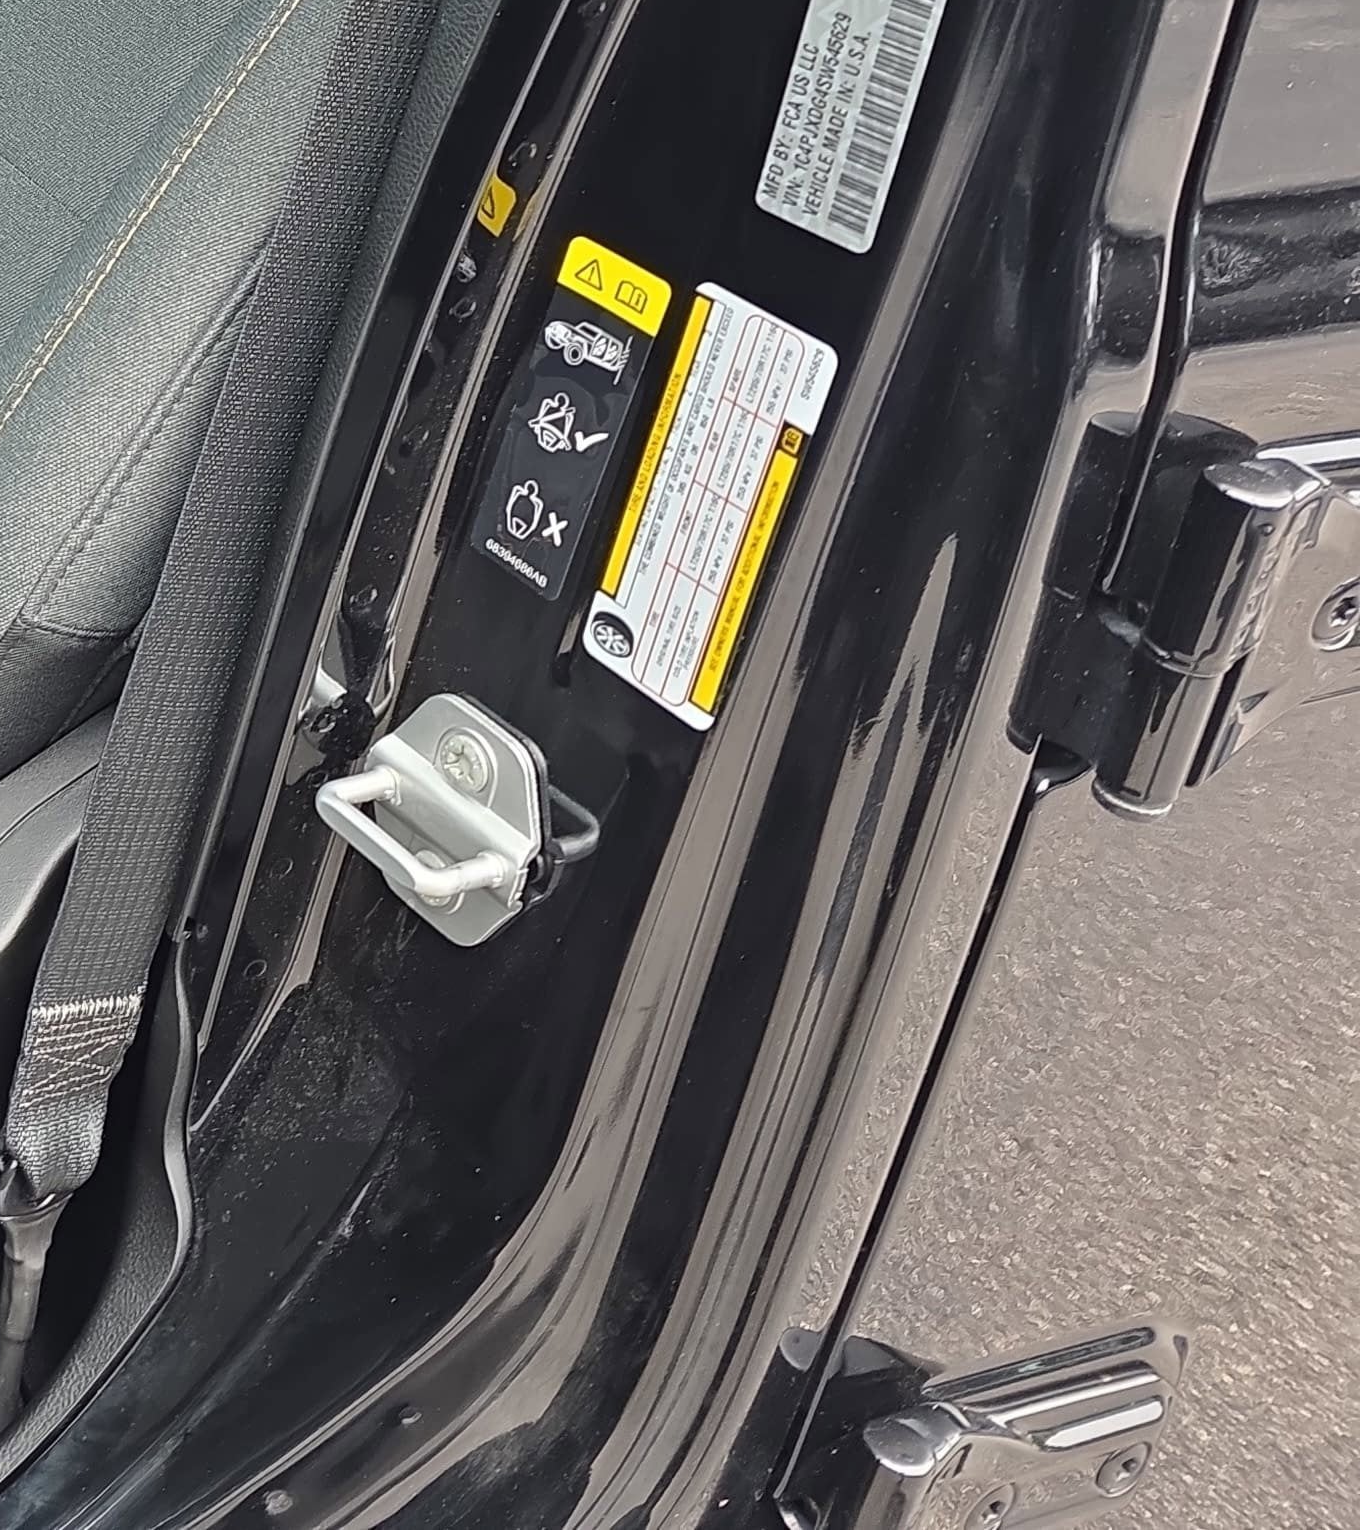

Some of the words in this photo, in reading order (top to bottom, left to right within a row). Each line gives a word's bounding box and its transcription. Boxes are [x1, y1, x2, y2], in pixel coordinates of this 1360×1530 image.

[796, 40, 819, 72] LLC
[841, 25, 871, 79] U.S.A.
[789, 71, 810, 98] US
[791, 9, 852, 173] 1C4PJXDG4SW545629
[834, 77, 856, 105] IN:
[780, 97, 803, 131] FCA
[820, 103, 848, 153] MADE
[771, 131, 793, 163] BY:
[761, 161, 785, 200] MFD
[781, 173, 805, 210] VIN:
[801, 151, 834, 219] VEHICLE
[635, 471, 648, 493] AND
[655, 370, 682, 433] INFORMATION
